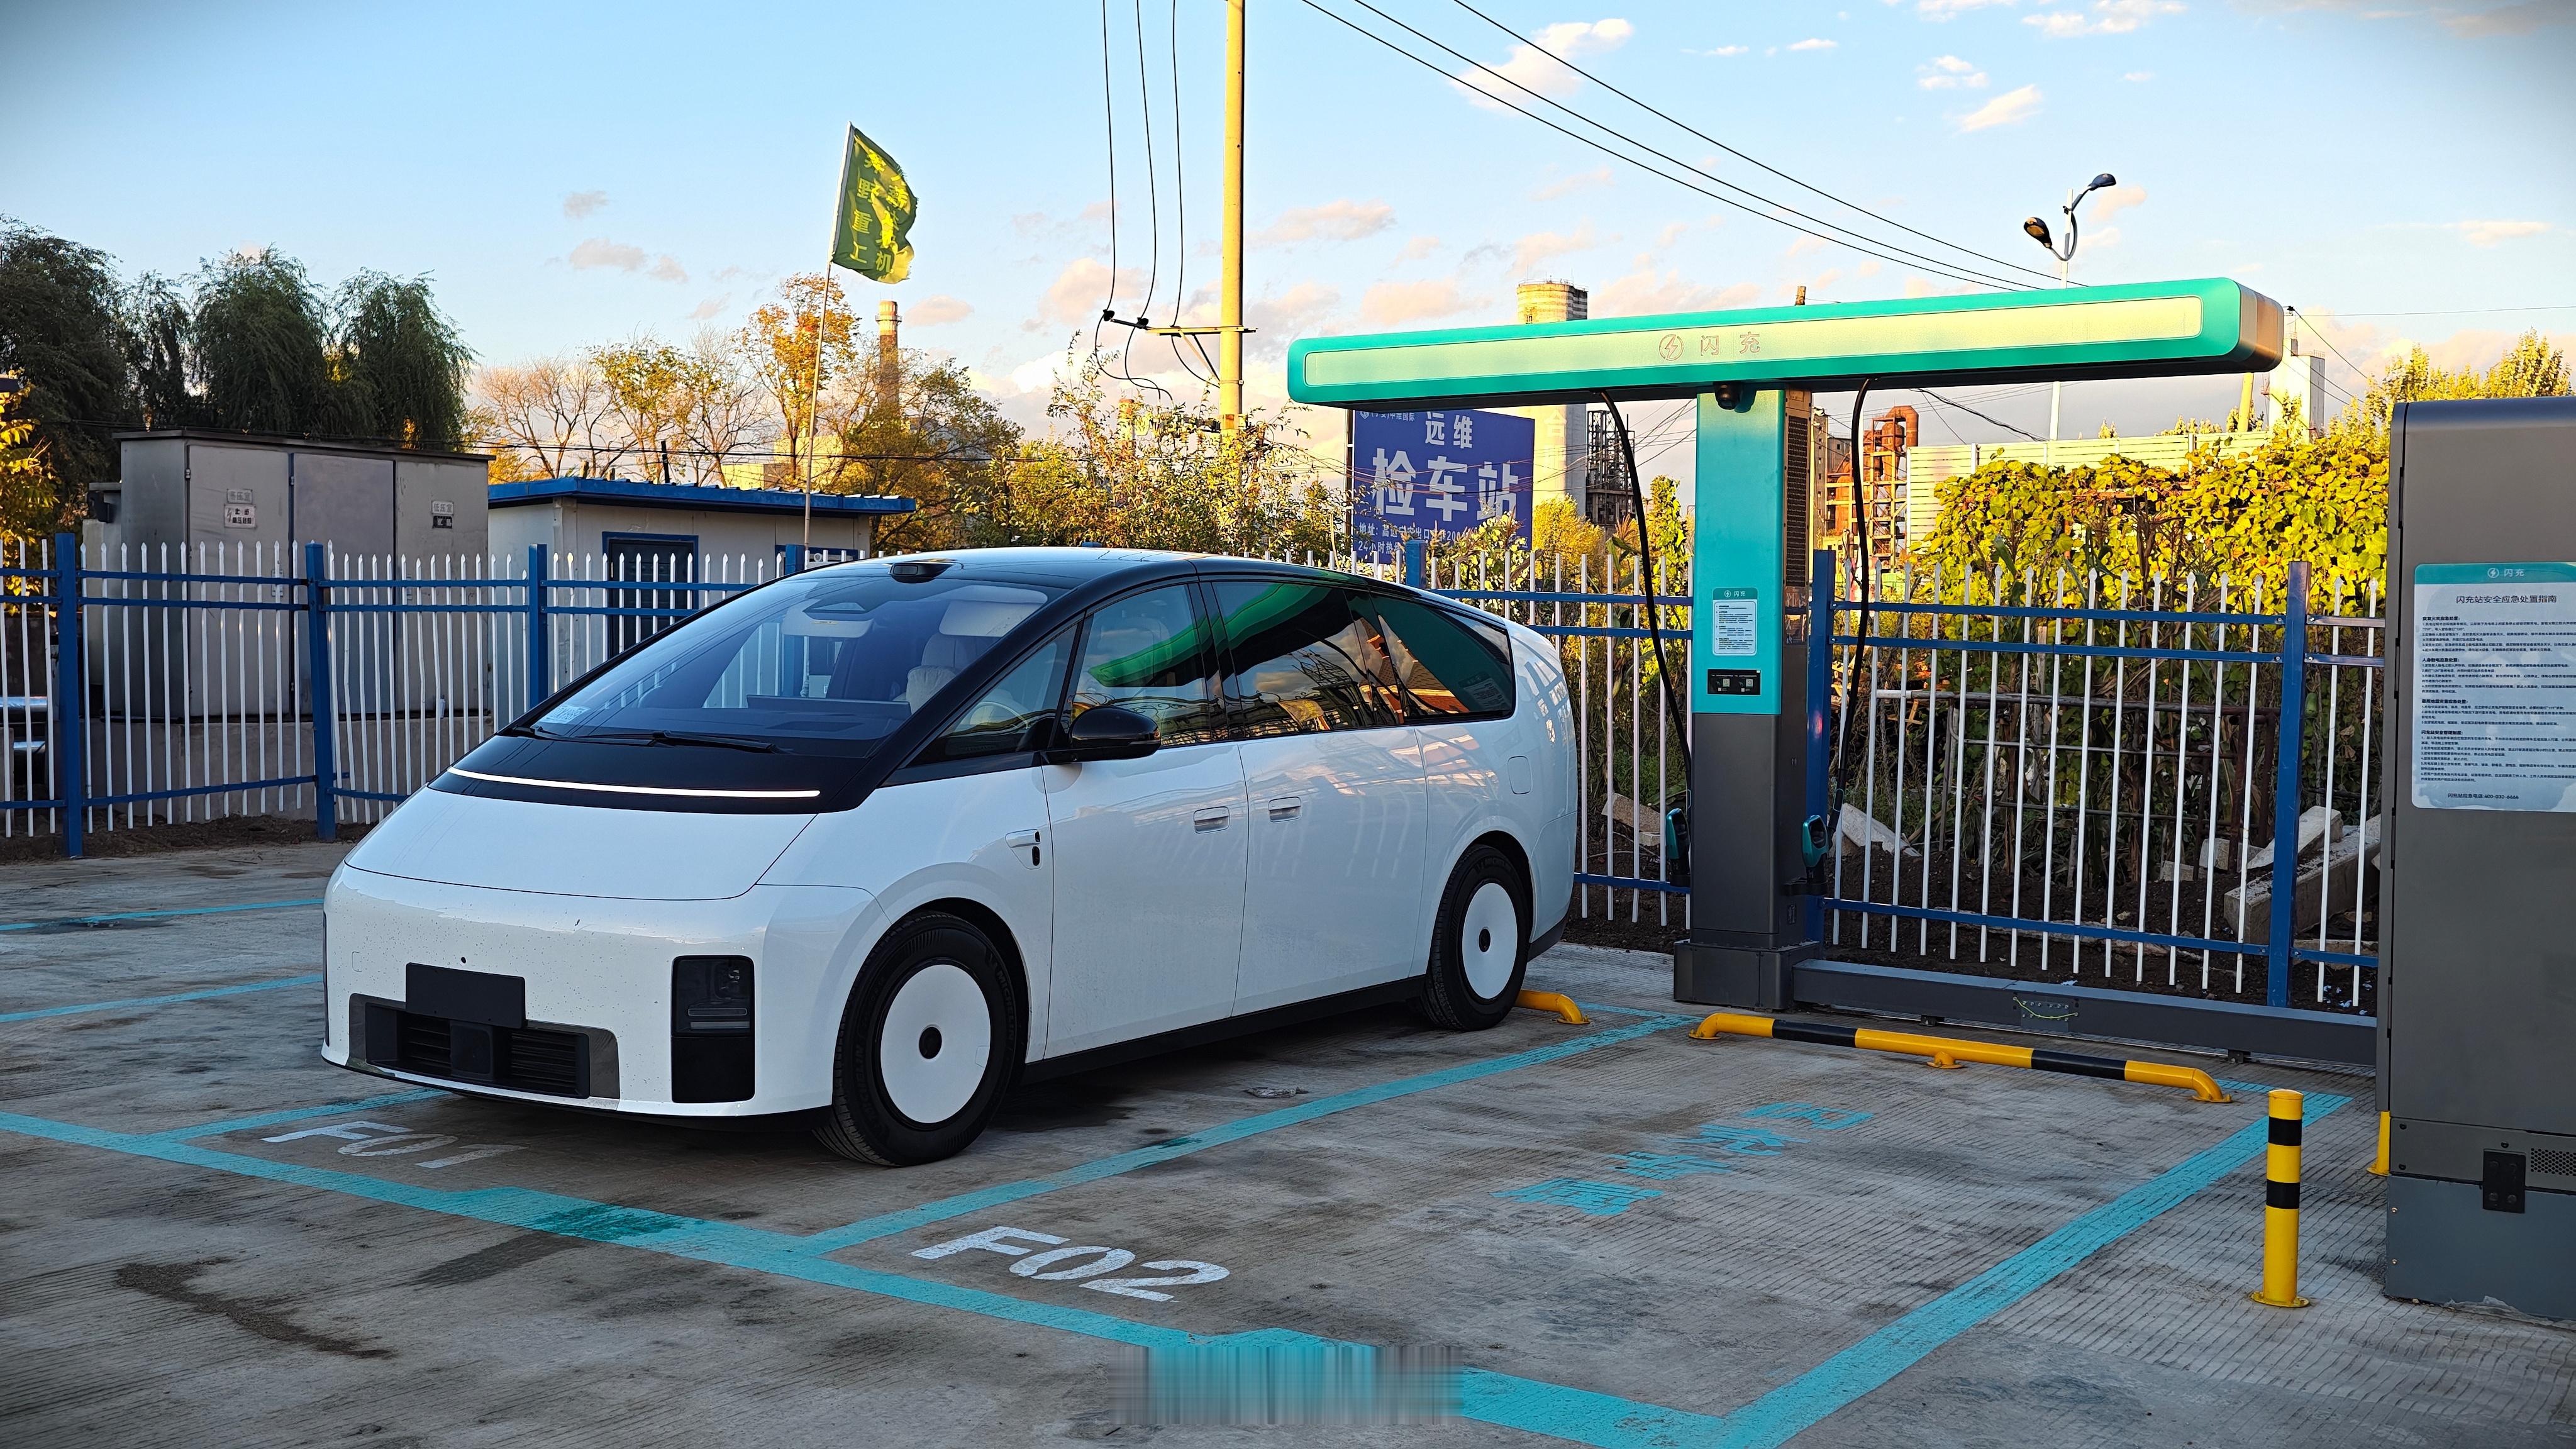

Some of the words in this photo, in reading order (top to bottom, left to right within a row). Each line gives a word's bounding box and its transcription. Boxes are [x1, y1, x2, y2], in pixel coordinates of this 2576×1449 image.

[1701, 331, 1760, 356] 闪充
[1425, 411, 1472, 448] 远维
[1372, 448, 1518, 522] 检车站
[2504, 569, 2524, 577] 闪充
[2456, 595, 2557, 604] 闪充站安全应急处置指南
[260, 1121, 528, 1169] F01
[908, 1226, 1230, 1302] F02
